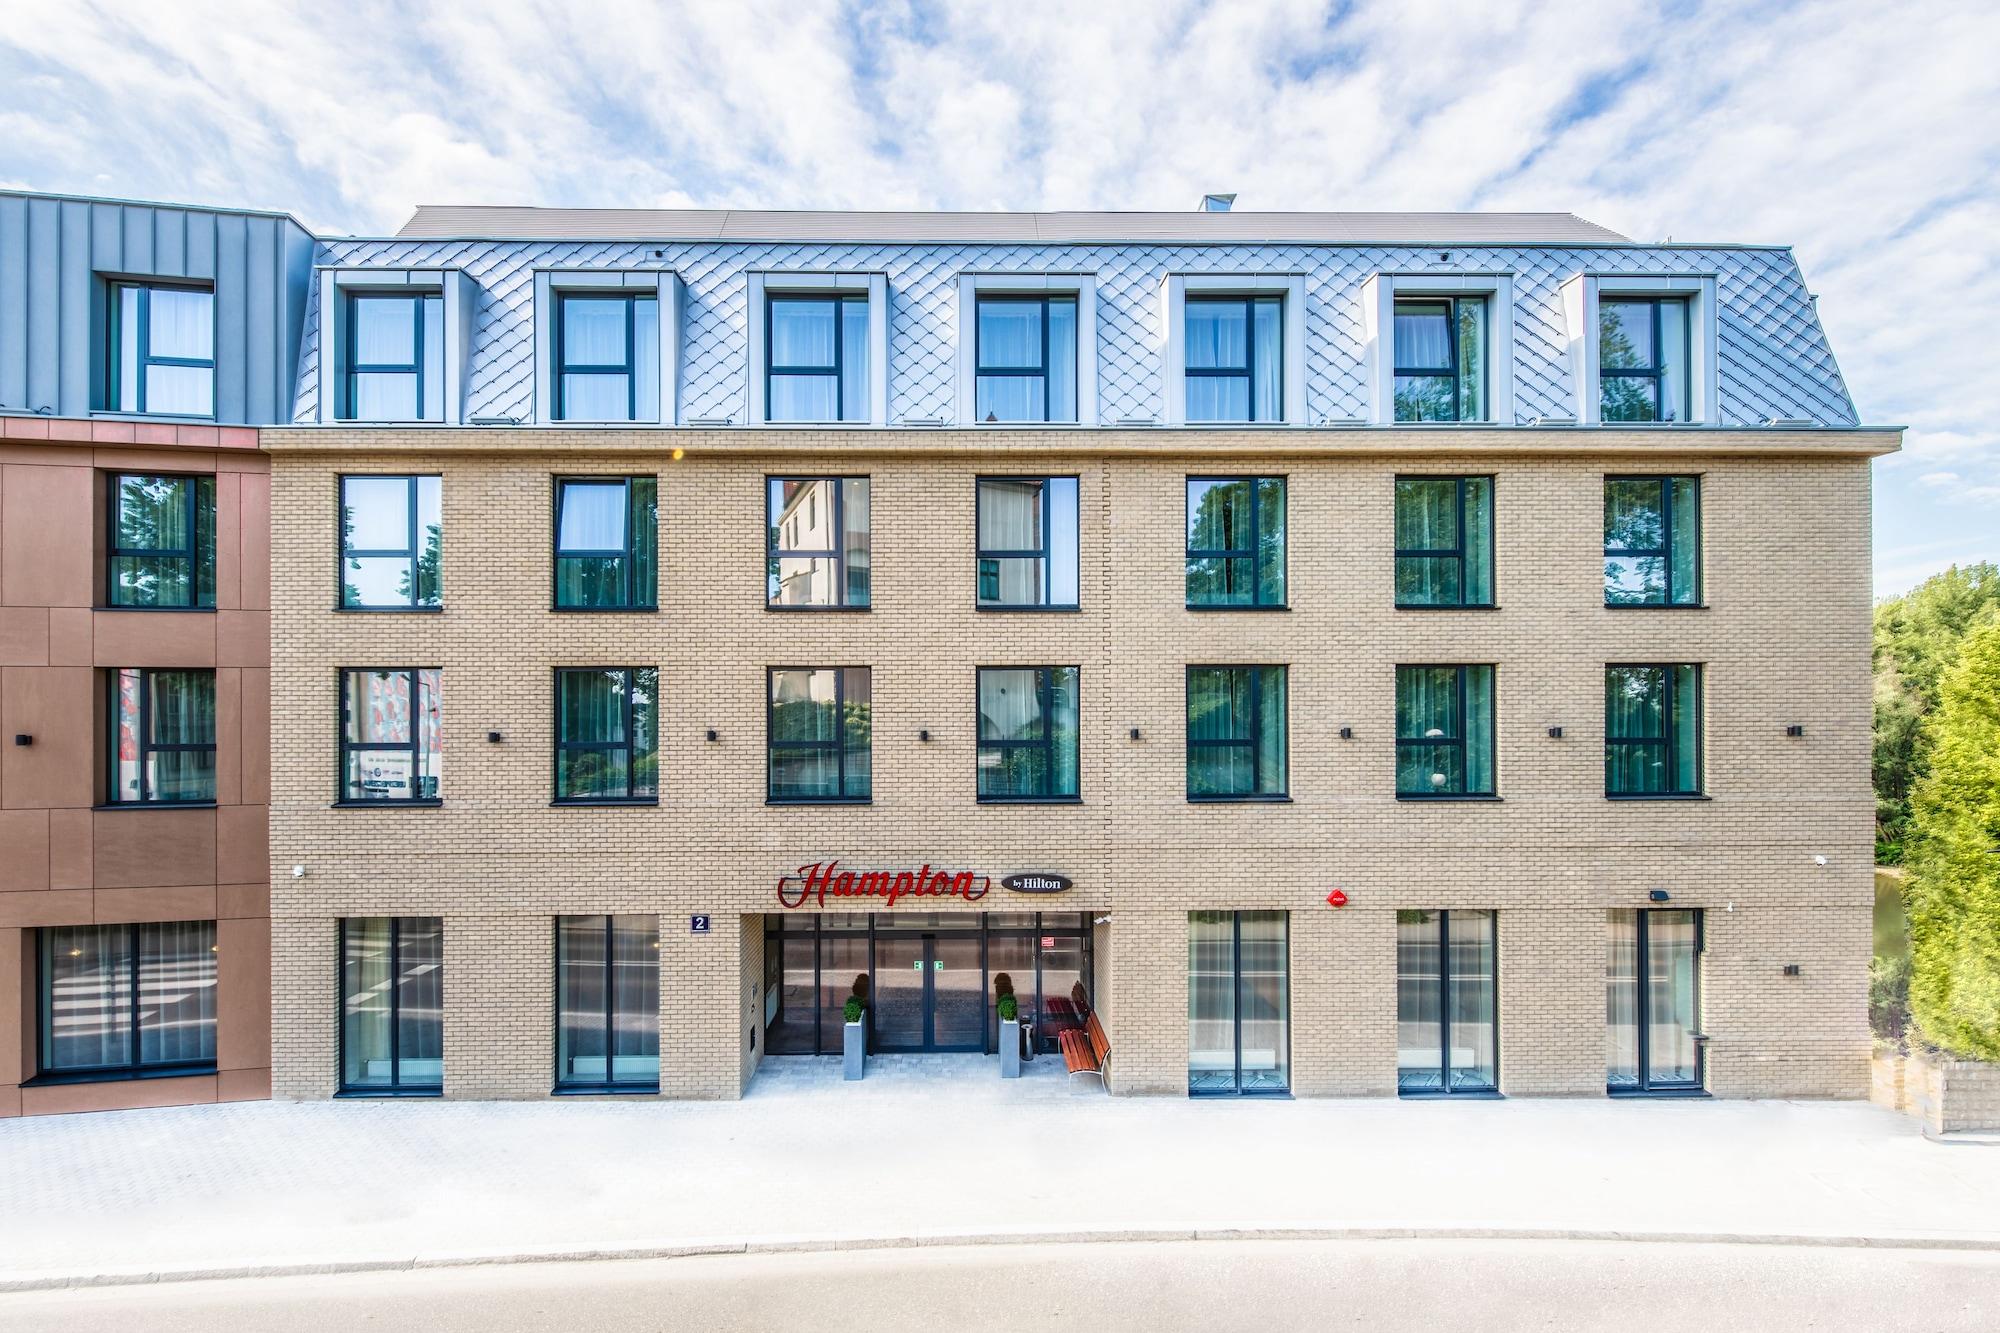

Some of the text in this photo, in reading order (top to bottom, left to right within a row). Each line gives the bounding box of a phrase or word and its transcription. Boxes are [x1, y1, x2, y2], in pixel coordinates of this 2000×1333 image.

[778, 860, 1061, 908] Hampton by Hilton
[695, 916, 705, 930] 2
